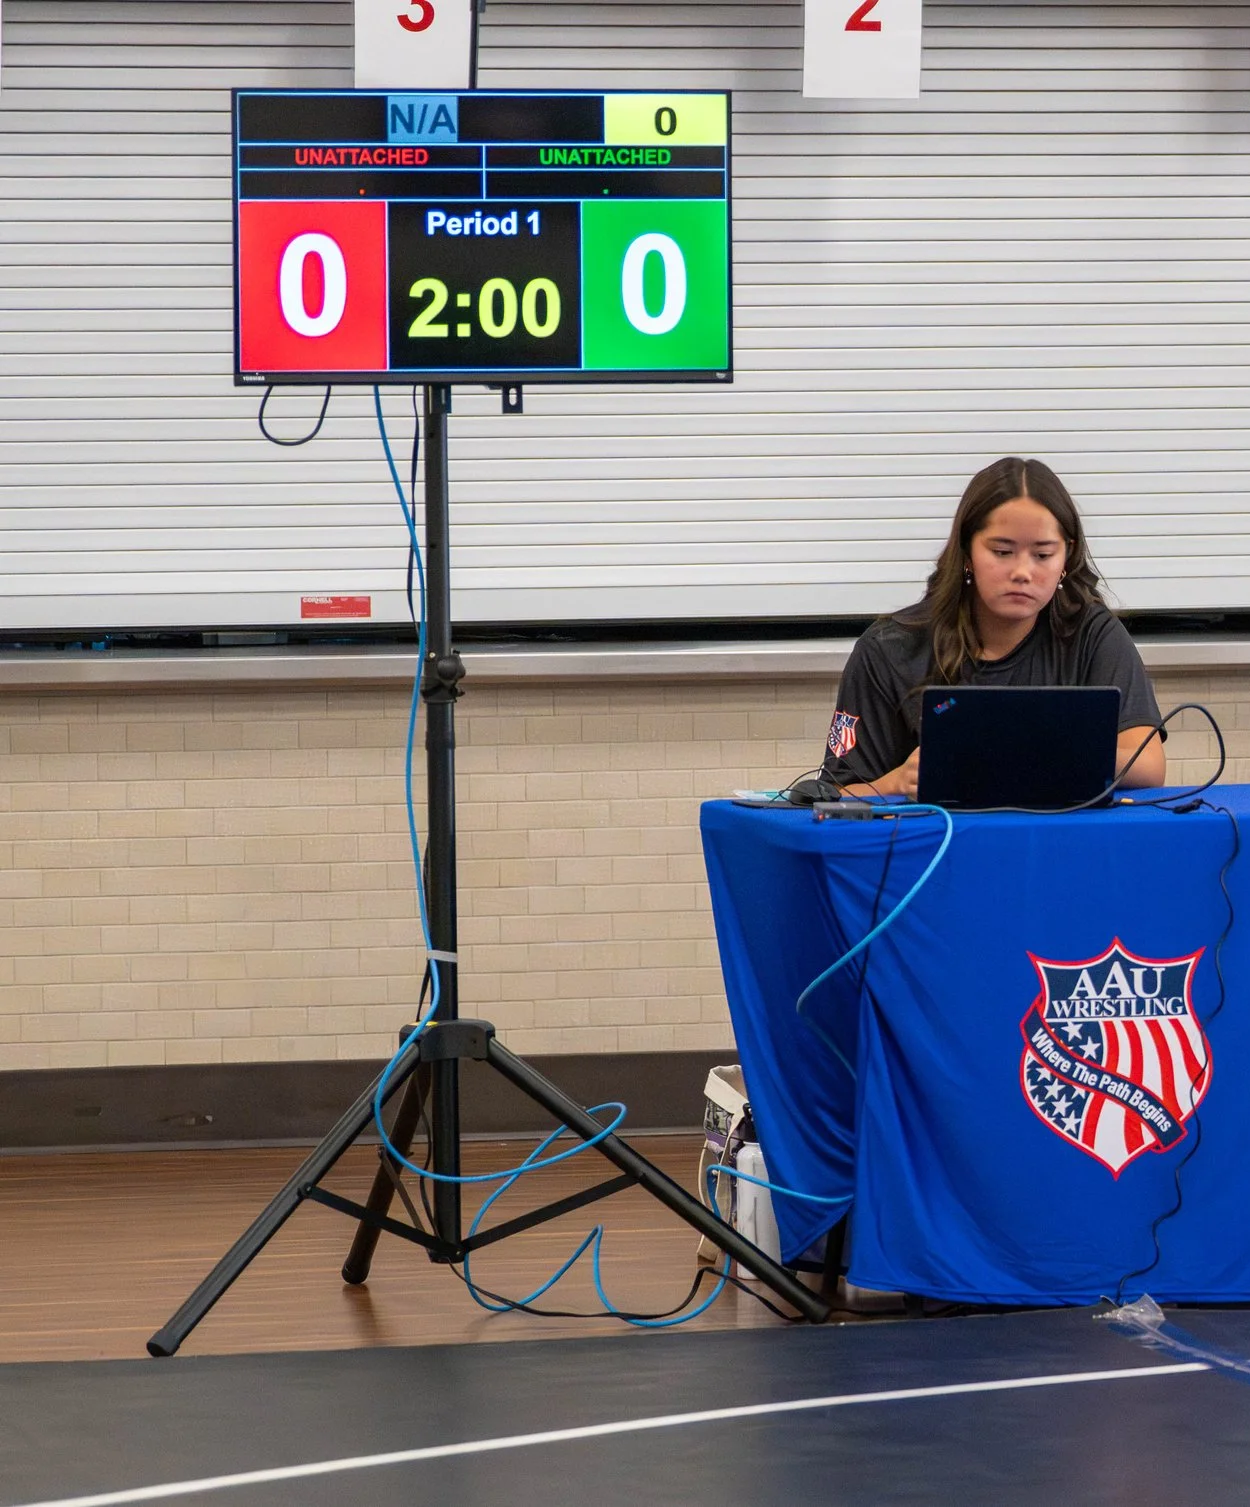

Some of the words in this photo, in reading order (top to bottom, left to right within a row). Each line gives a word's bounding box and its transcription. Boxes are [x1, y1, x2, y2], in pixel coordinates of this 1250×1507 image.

[844, 0, 882, 31] 2
[390, 104, 456, 134] N/A
[655, 107, 677, 136] 0
[294, 148, 429, 165] UNATTACHED
[539, 148, 672, 165] UNATTACHED
[427, 211, 518, 235] Period
[527, 211, 541, 235] 1
[279, 232, 347, 337] 0
[621, 232, 687, 336] 0
[408, 277, 562, 338] 2:00
[1068, 961, 1166, 1000] AAU
[1051, 996, 1184, 1018] WRESTLING
[1031, 1027, 1071, 1073] Where
[1071, 1062, 1098, 1086] The
[1099, 1075, 1132, 1101] Path
[1129, 1090, 1173, 1133] Begins
